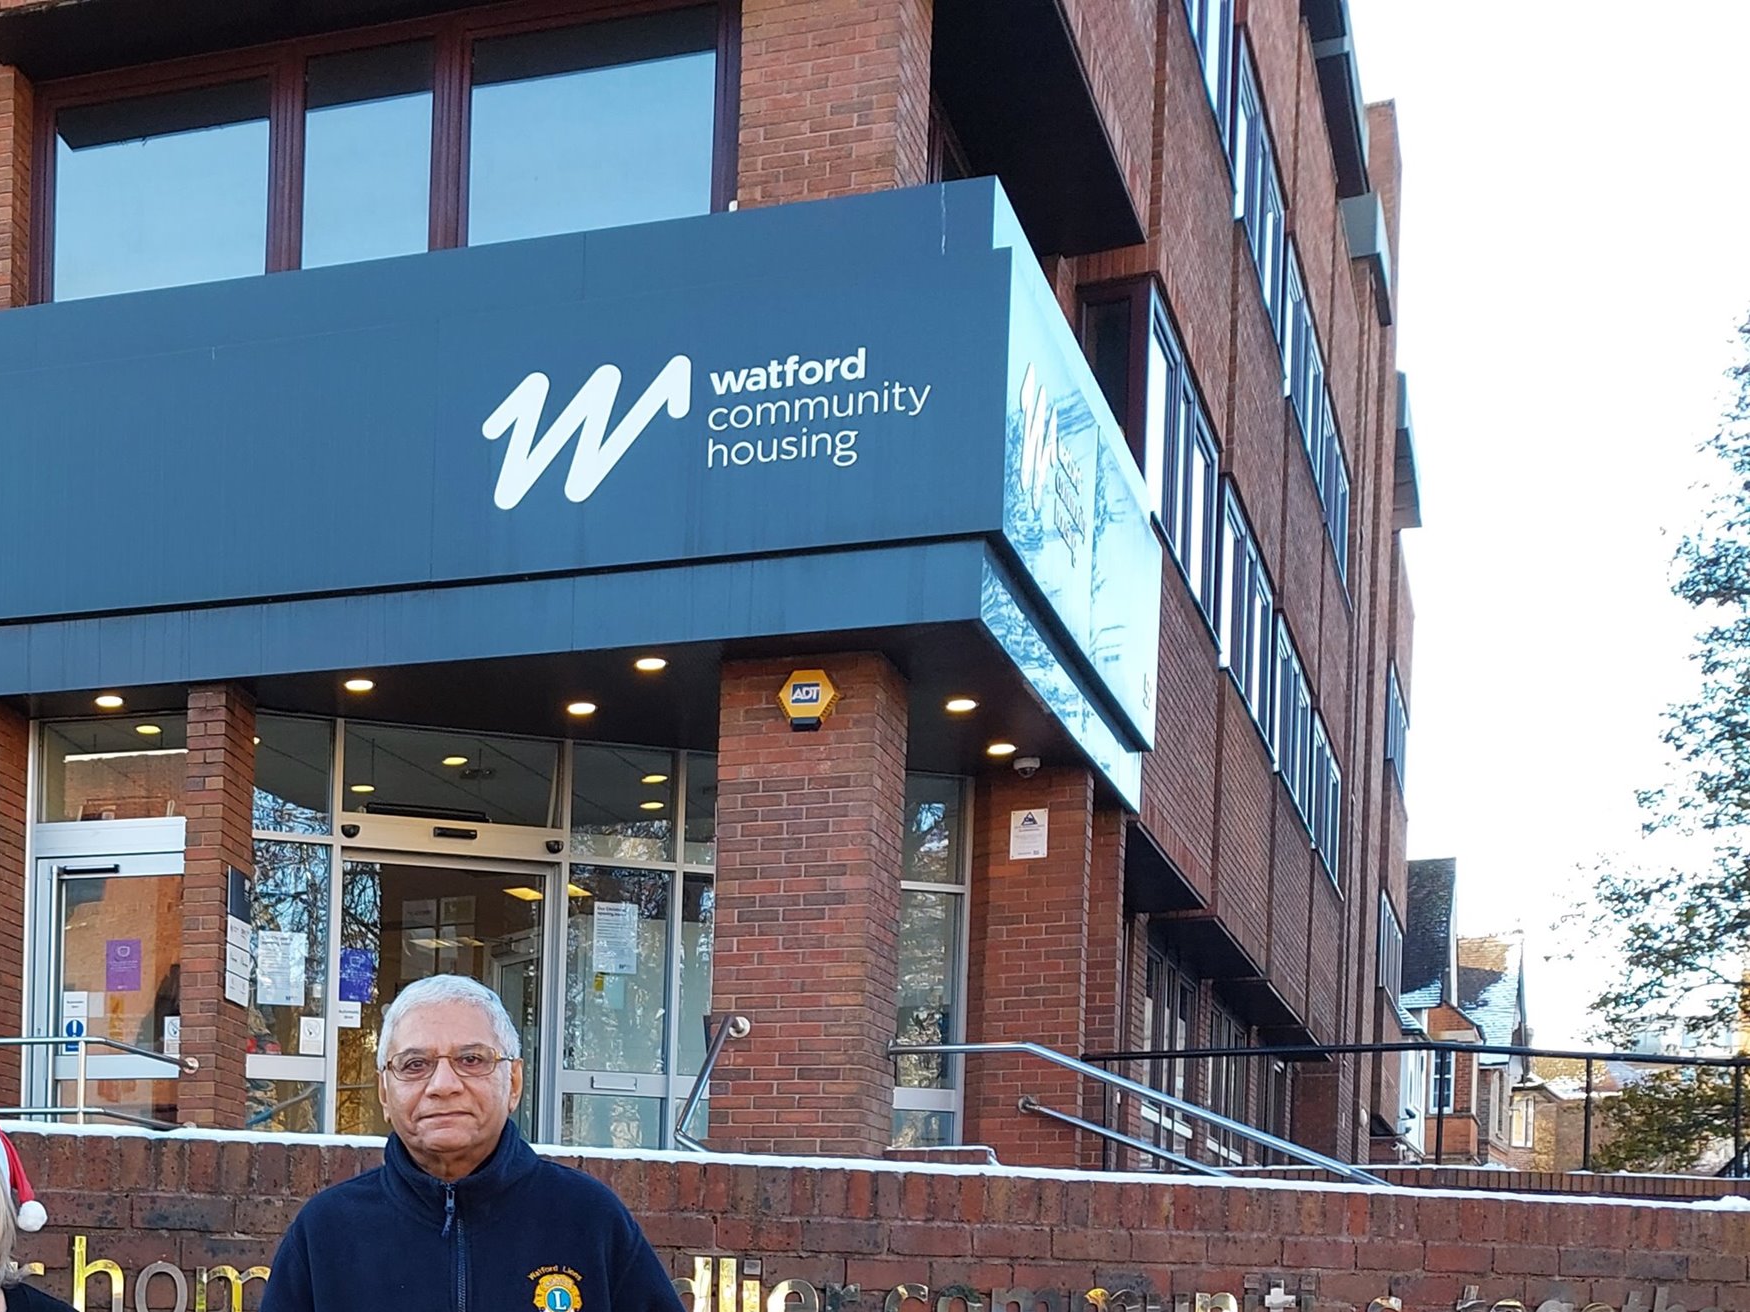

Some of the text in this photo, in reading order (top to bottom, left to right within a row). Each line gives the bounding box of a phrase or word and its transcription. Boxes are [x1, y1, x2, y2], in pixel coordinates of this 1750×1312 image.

[709, 347, 867, 395] watford
[707, 380, 932, 431] community
[707, 428, 858, 468] housing
[792, 686, 820, 700] ADT
[528, 1265, 582, 1281] Watford Lions
